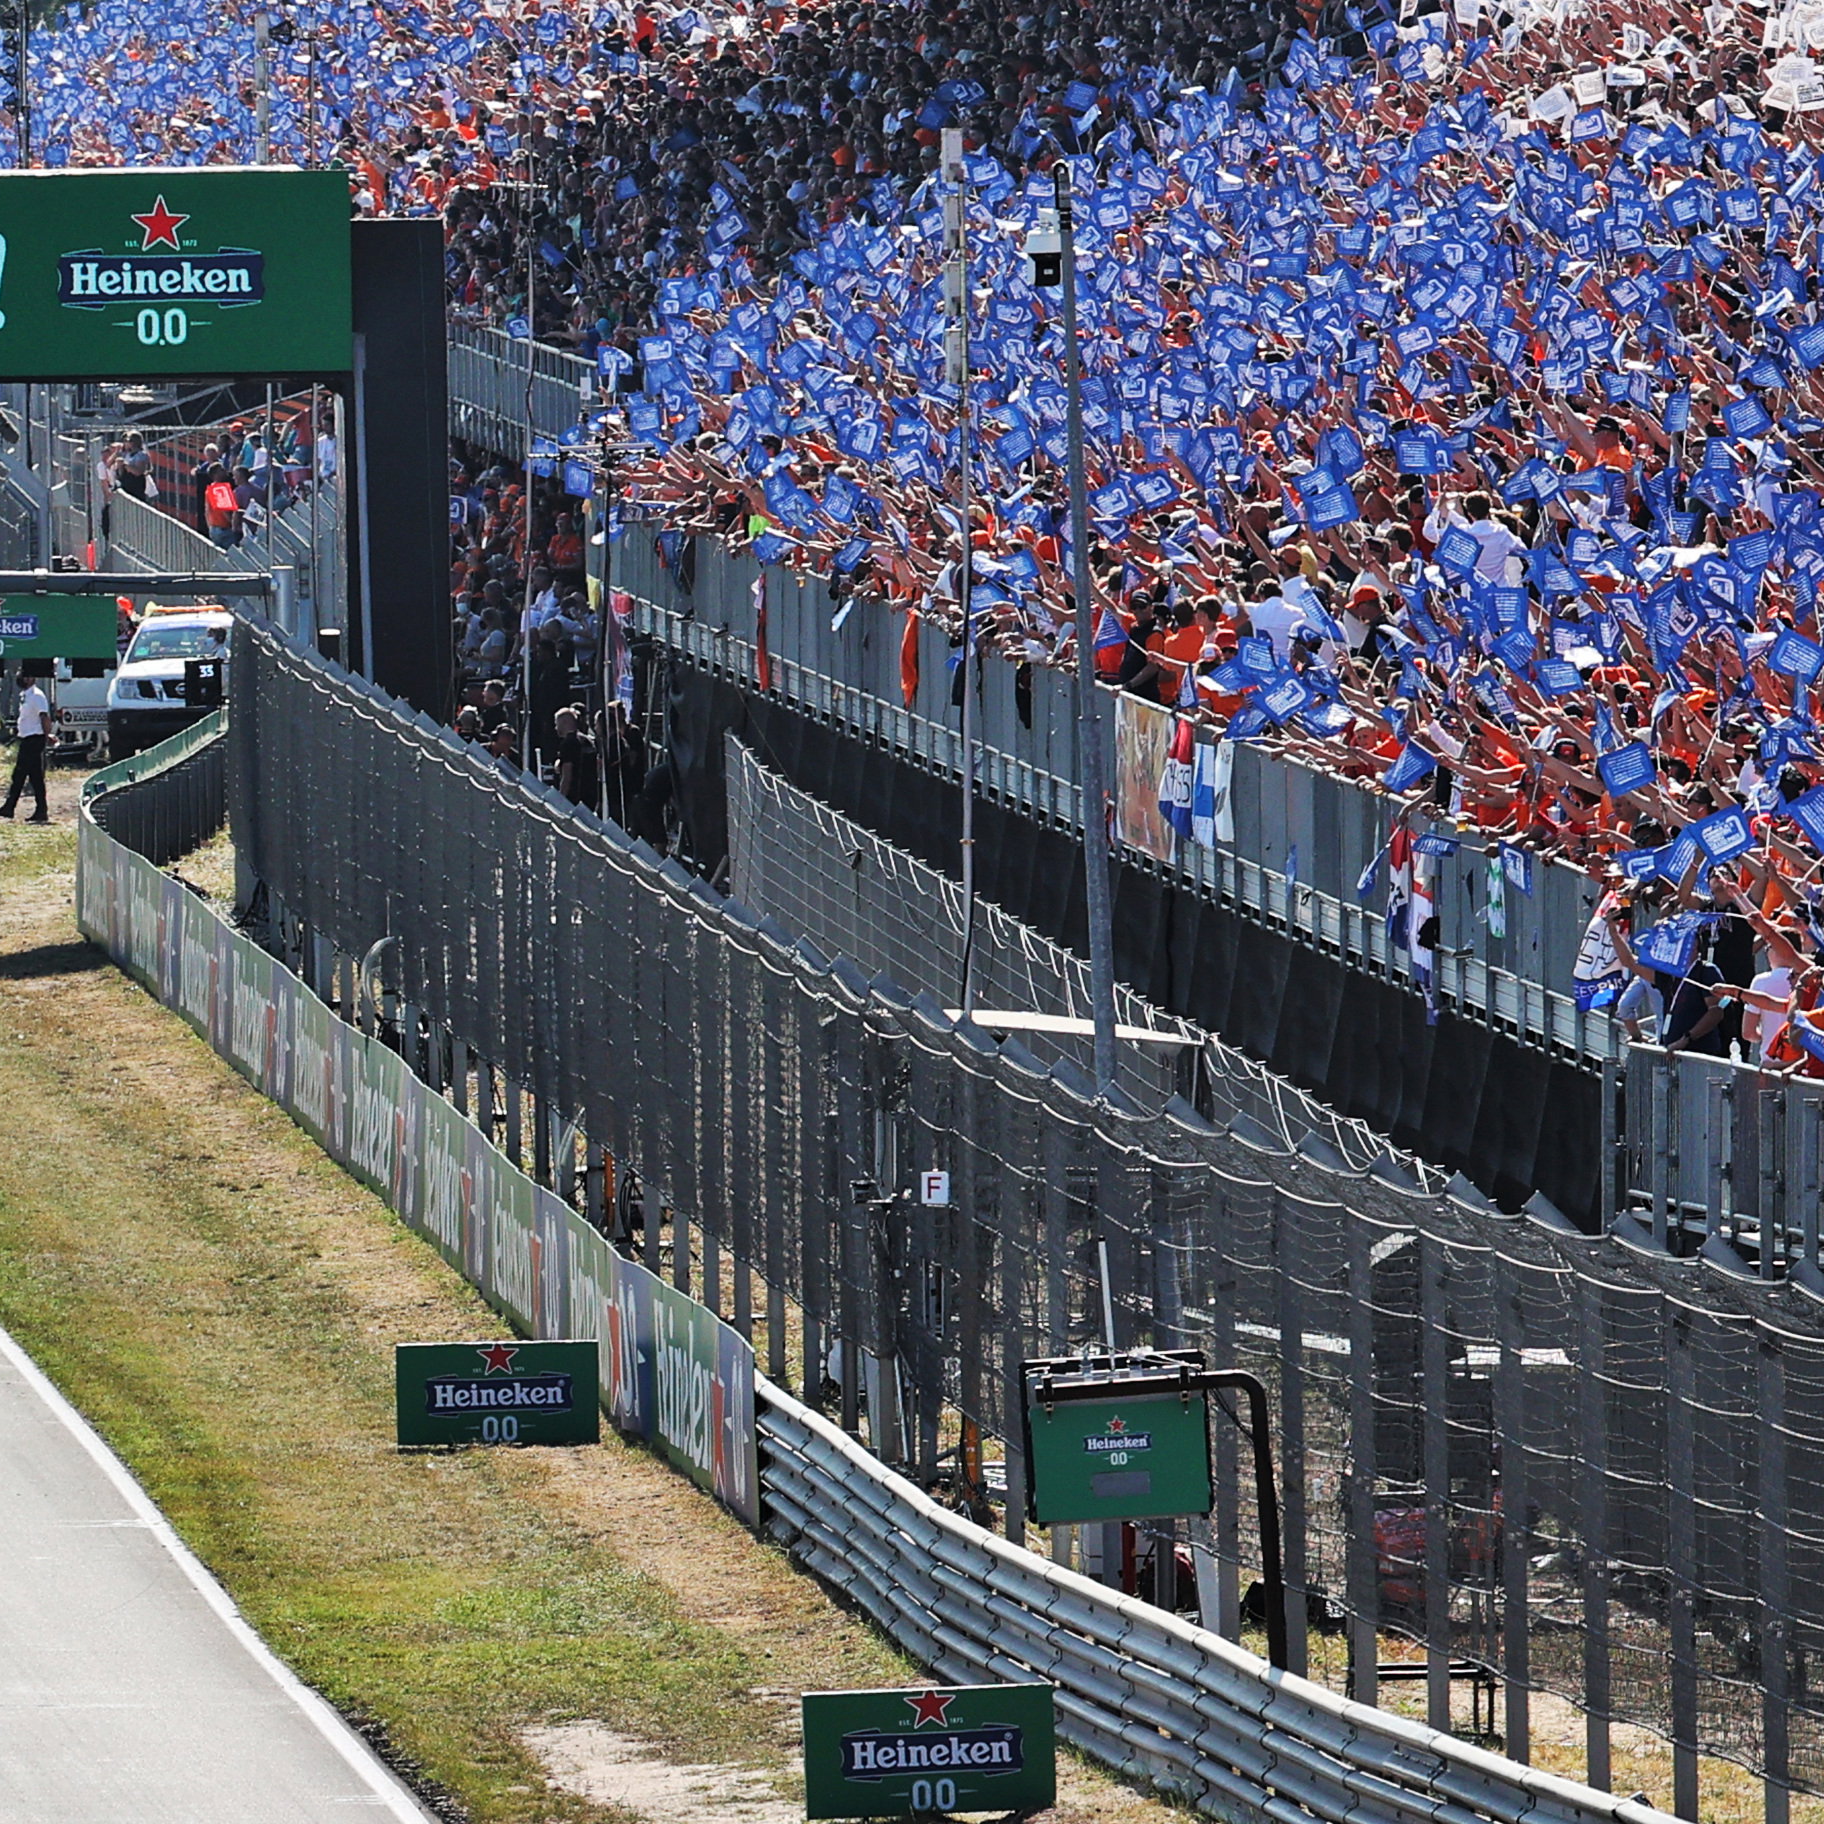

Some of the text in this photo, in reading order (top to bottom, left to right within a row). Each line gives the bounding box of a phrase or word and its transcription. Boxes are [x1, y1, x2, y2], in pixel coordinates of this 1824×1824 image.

[70, 262, 252, 295] Heineken
[137, 308, 187, 346] 0.0
[199, 664, 214, 677] 33
[927, 1176, 942, 1199] F
[434, 1383, 564, 1408] Heineken
[482, 1416, 518, 1442] 0.0
[1087, 1435, 1148, 1451] Heineken
[1110, 1452, 1128, 1466] 0.0
[851, 1736, 1013, 1770] Heineken
[912, 1778, 955, 1811] 0.0
